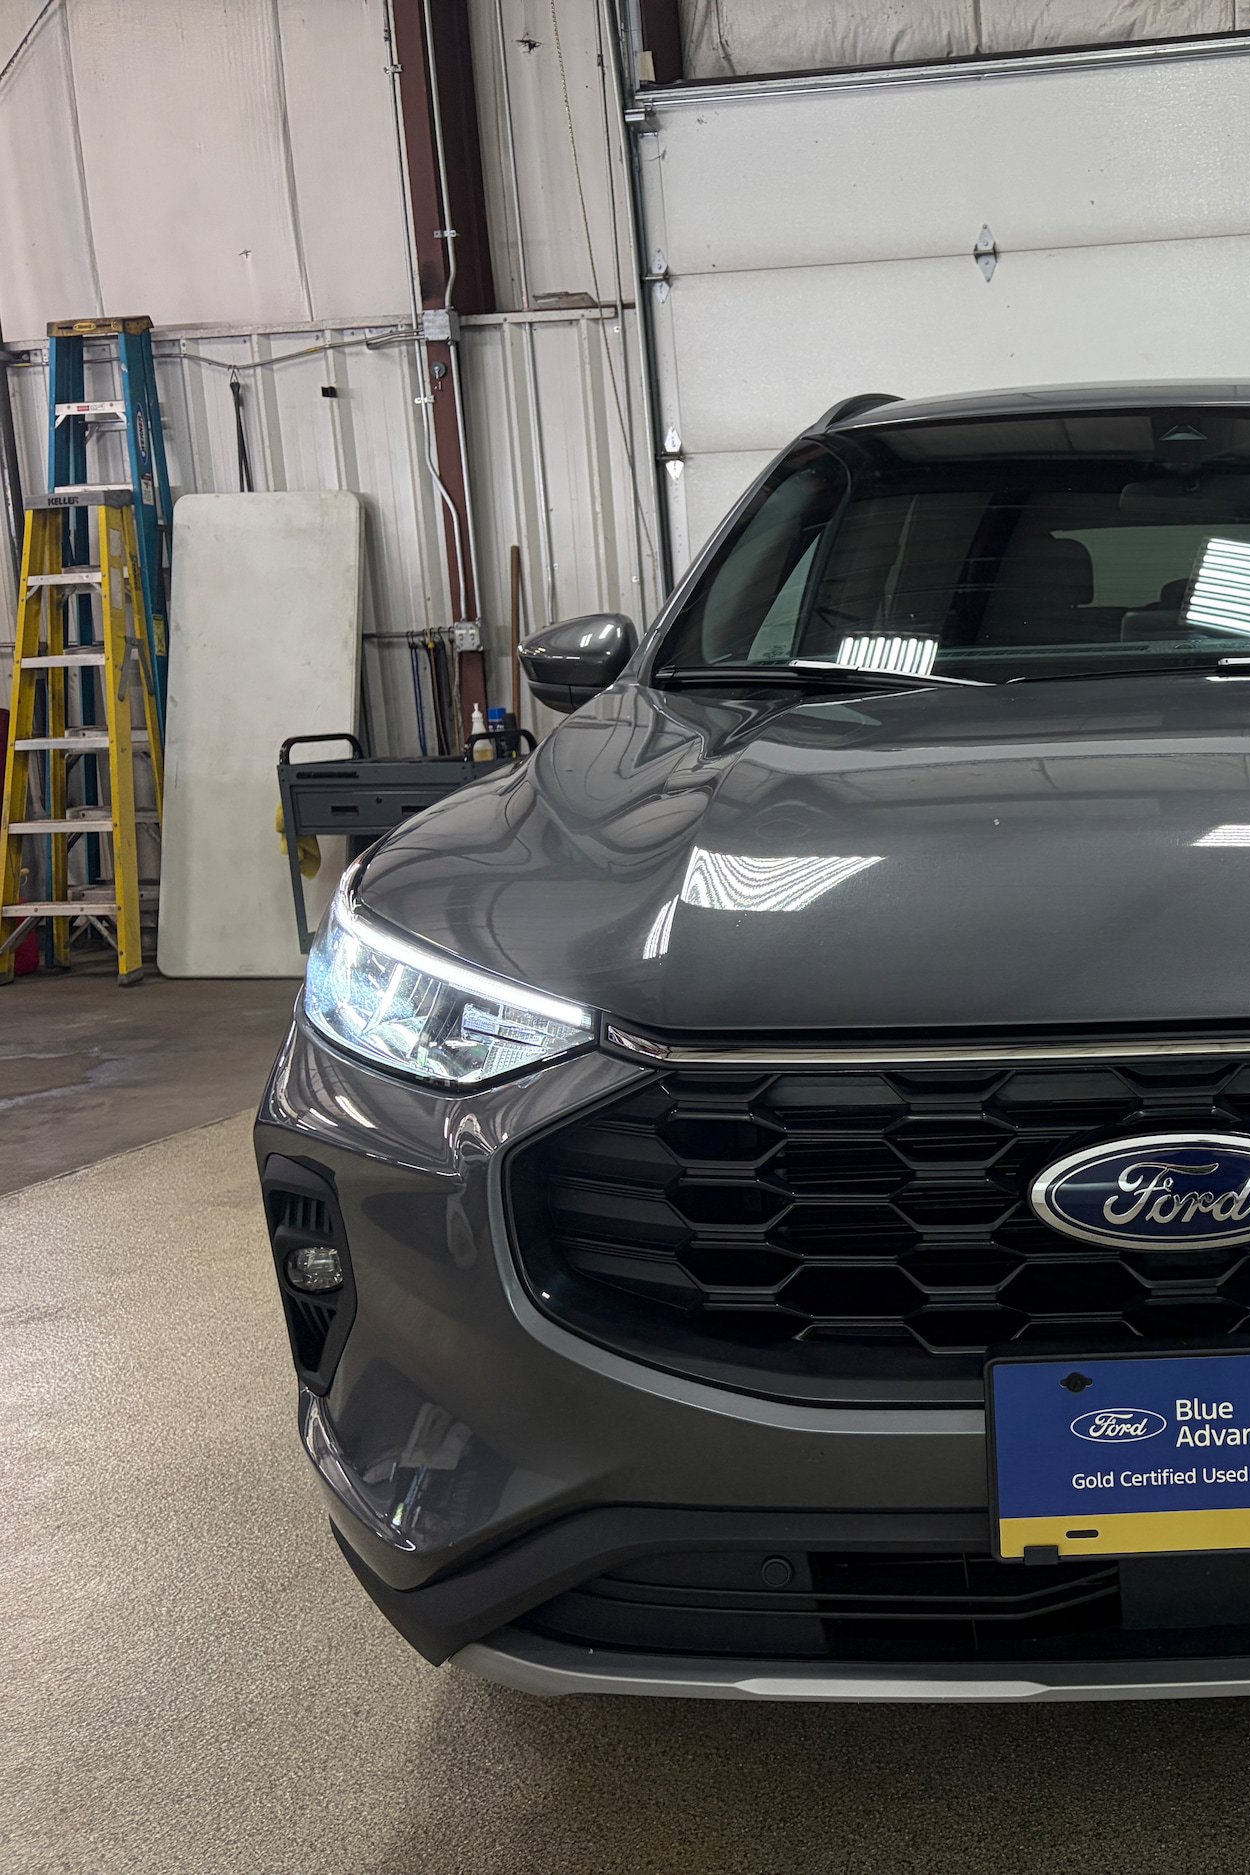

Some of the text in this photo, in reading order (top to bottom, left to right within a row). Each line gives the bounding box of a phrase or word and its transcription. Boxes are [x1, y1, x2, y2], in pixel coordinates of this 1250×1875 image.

[48, 496, 79, 506] KELLER
[1176, 1398, 1233, 1420] Blue
[1089, 1413, 1148, 1437] Ford
[1072, 1472, 1113, 1489] Gold
[1121, 1468, 1196, 1486] Certified
[1203, 1466, 1248, 1483] Used
